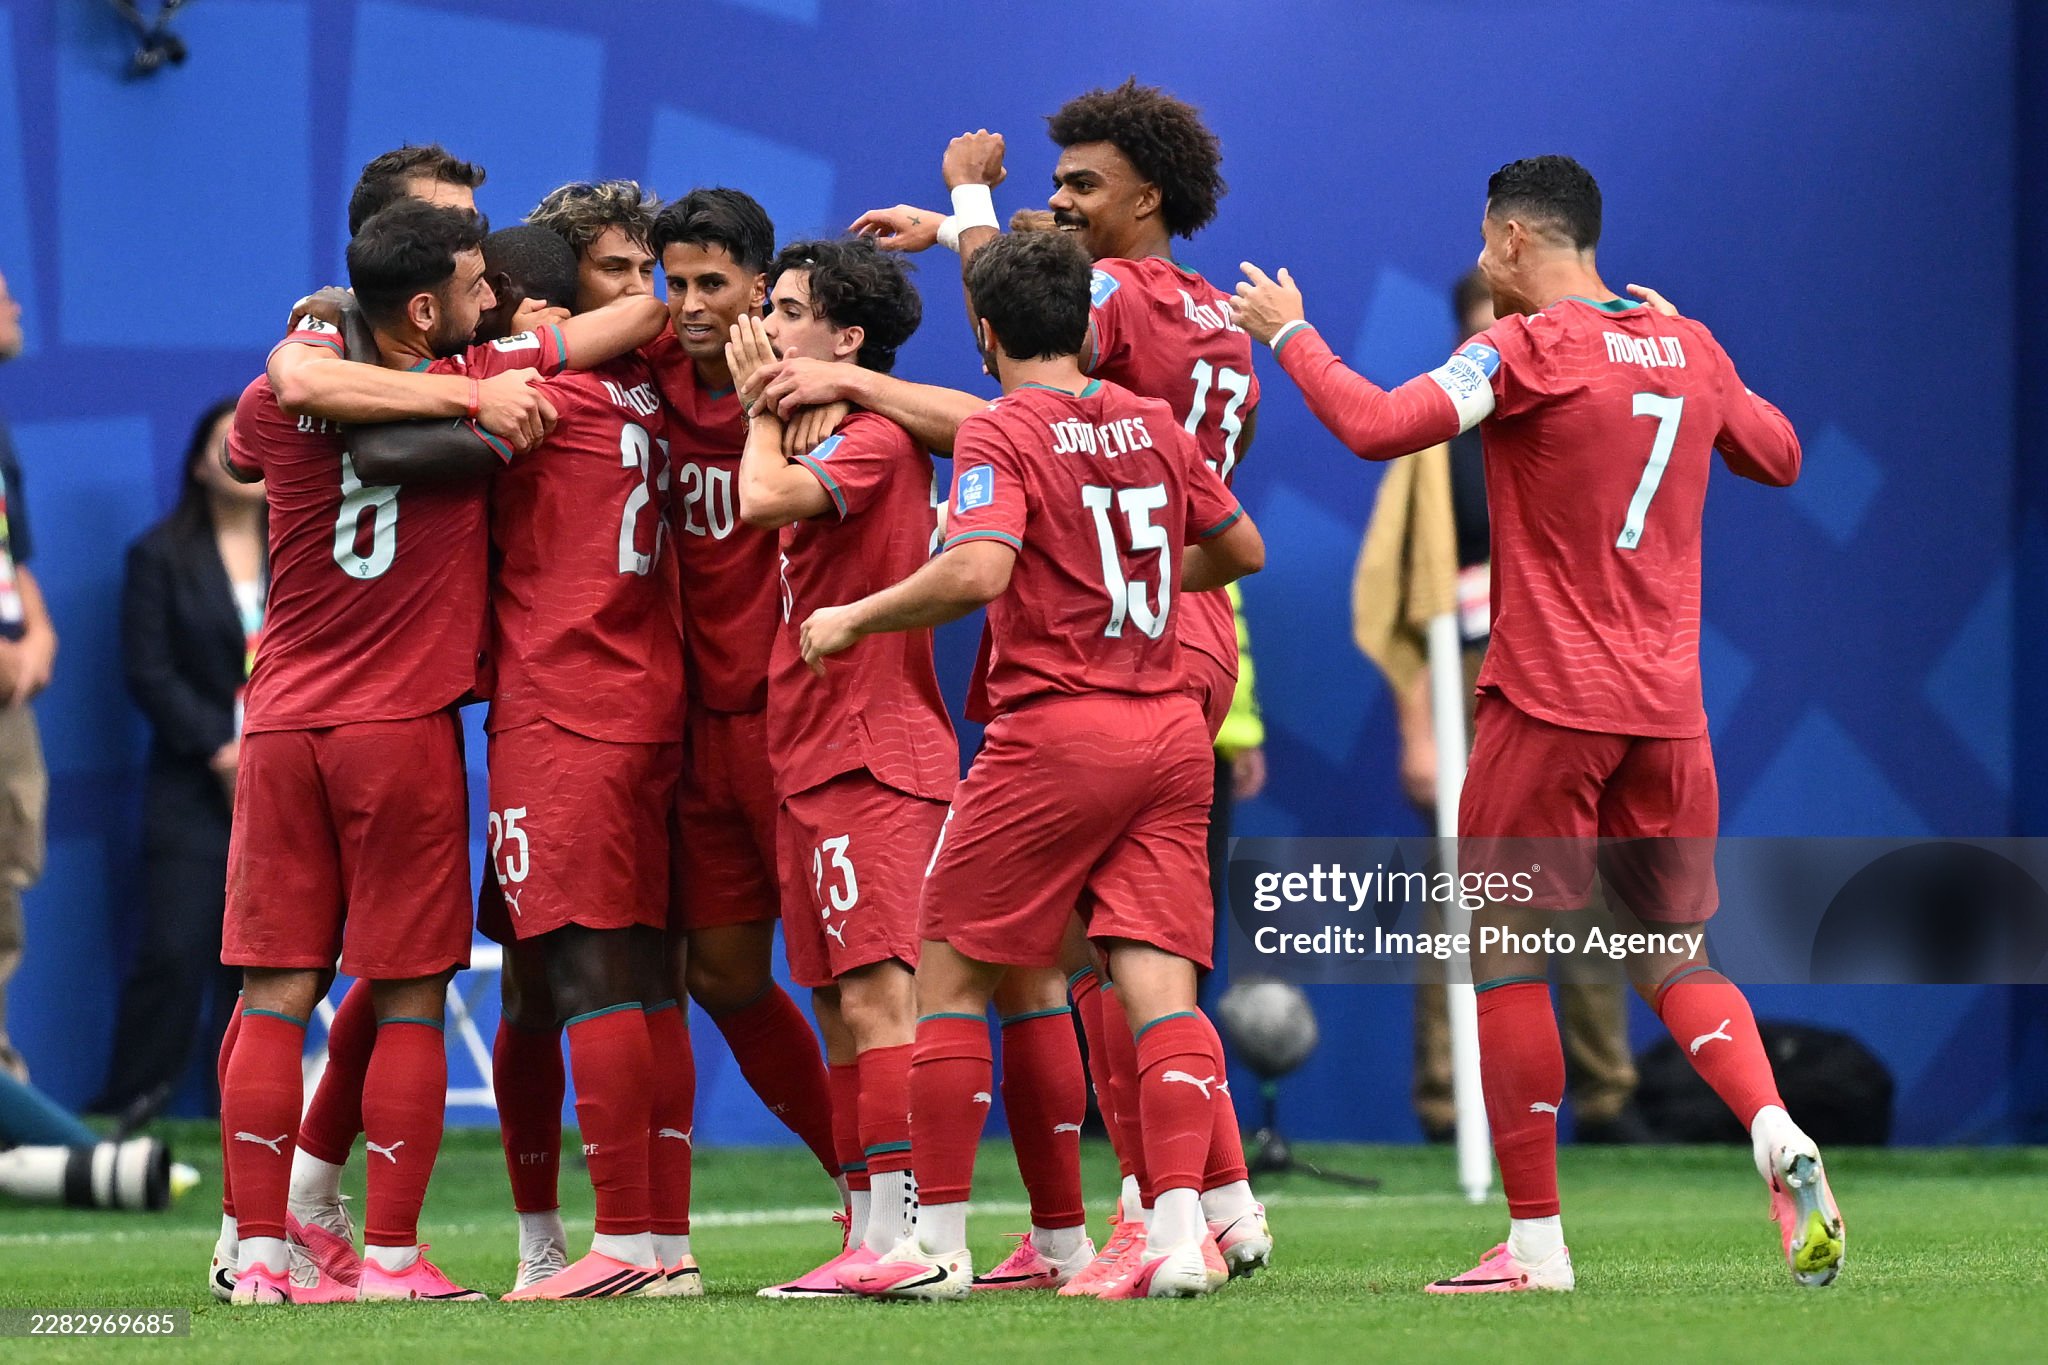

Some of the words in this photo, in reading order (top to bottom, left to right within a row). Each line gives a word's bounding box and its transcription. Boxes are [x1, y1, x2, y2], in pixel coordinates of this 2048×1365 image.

[680, 463, 734, 540] 20
[1615, 392, 1685, 550] 7
[1081, 482, 1171, 639] 15
[488, 806, 530, 885] 25
[813, 834, 859, 919] 23
